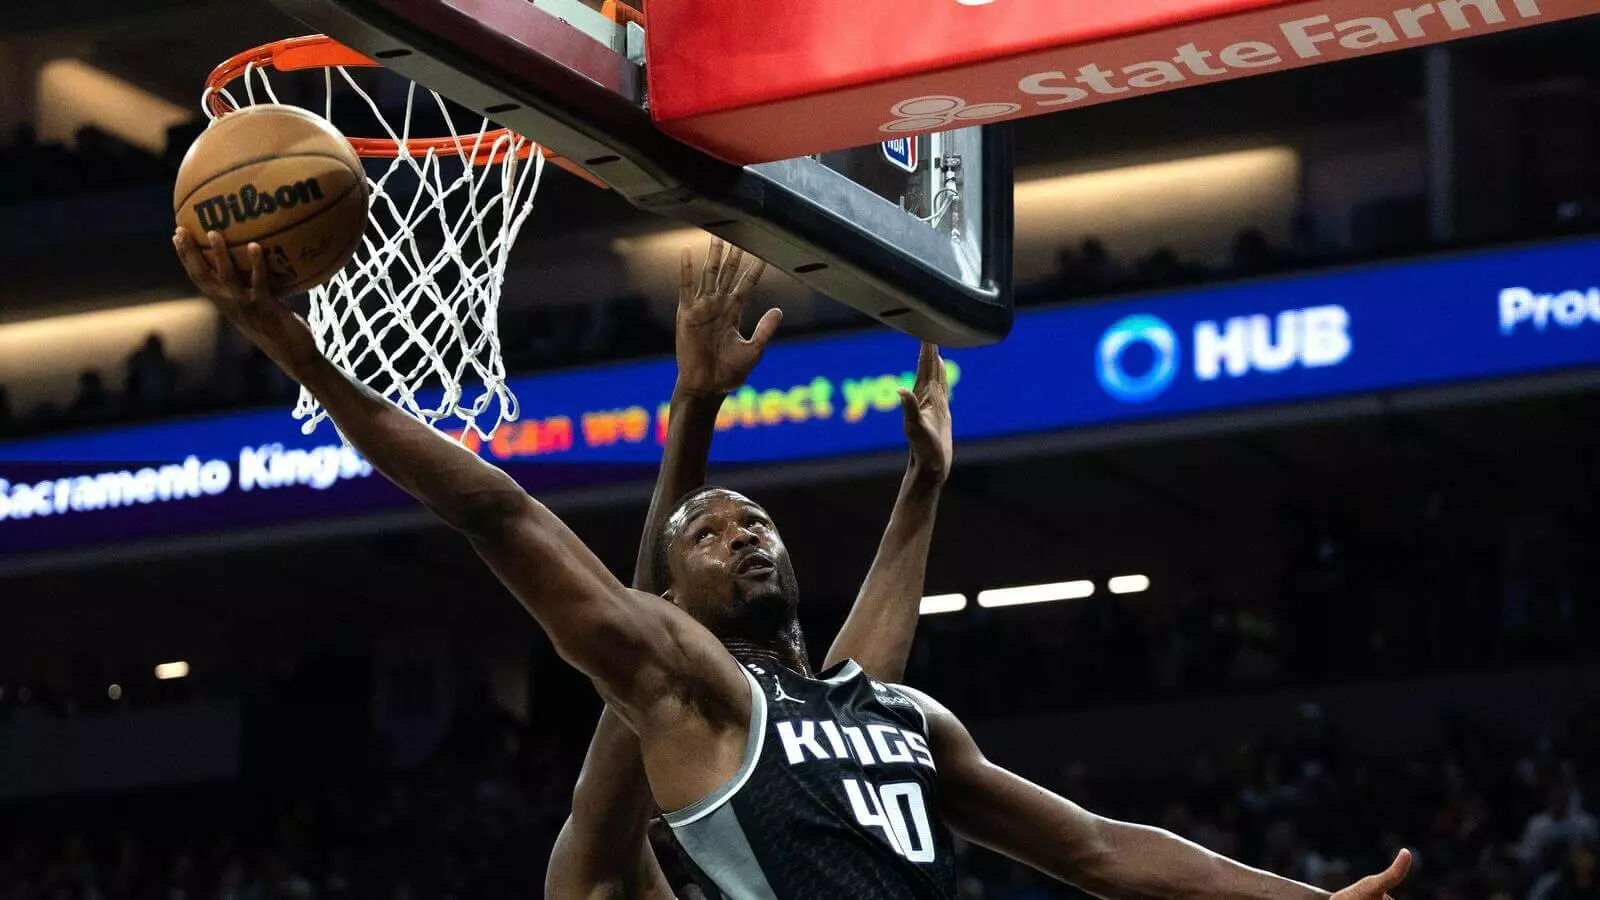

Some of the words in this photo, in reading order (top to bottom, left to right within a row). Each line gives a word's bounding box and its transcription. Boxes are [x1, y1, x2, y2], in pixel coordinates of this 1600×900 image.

[1017, 40, 1282, 107] State
[194, 178, 323, 231] Wilson
[1194, 305, 1352, 380] HUB
[490, 416, 573, 459] can
[582, 406, 649, 446] we
[656, 377, 834, 447] otect
[776, 720, 936, 776] KINGS
[842, 779, 935, 862] 40
